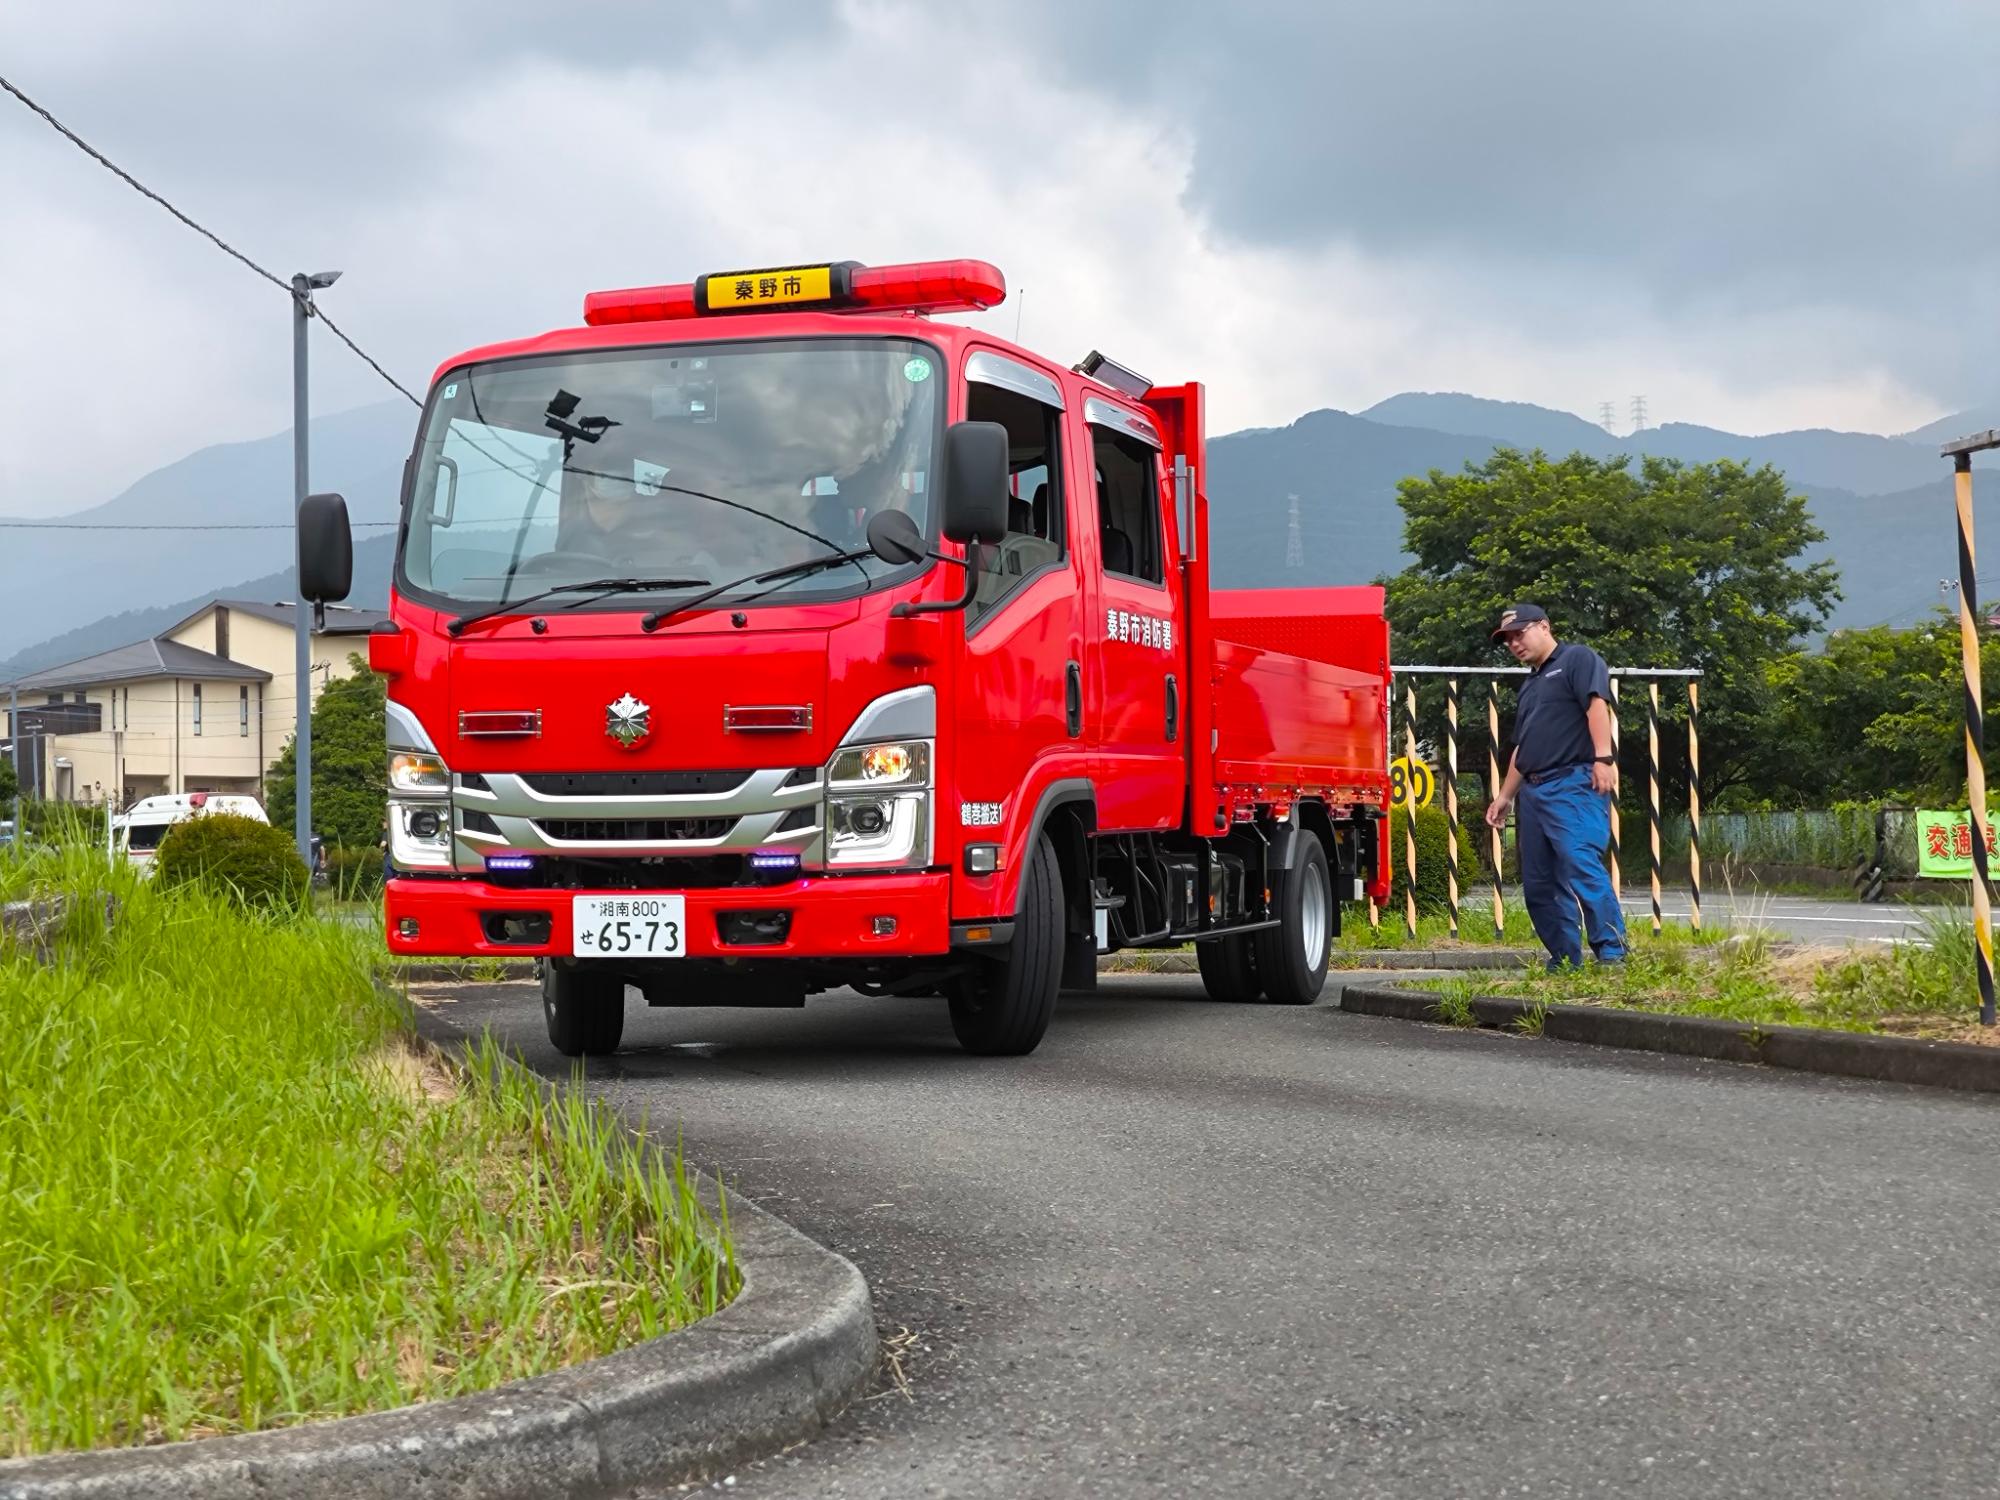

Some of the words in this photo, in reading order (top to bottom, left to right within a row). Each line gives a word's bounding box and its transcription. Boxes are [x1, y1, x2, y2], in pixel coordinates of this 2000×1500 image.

[735, 275, 802, 301] 秦野市
[1107, 608, 1172, 651] 秦野市消防署
